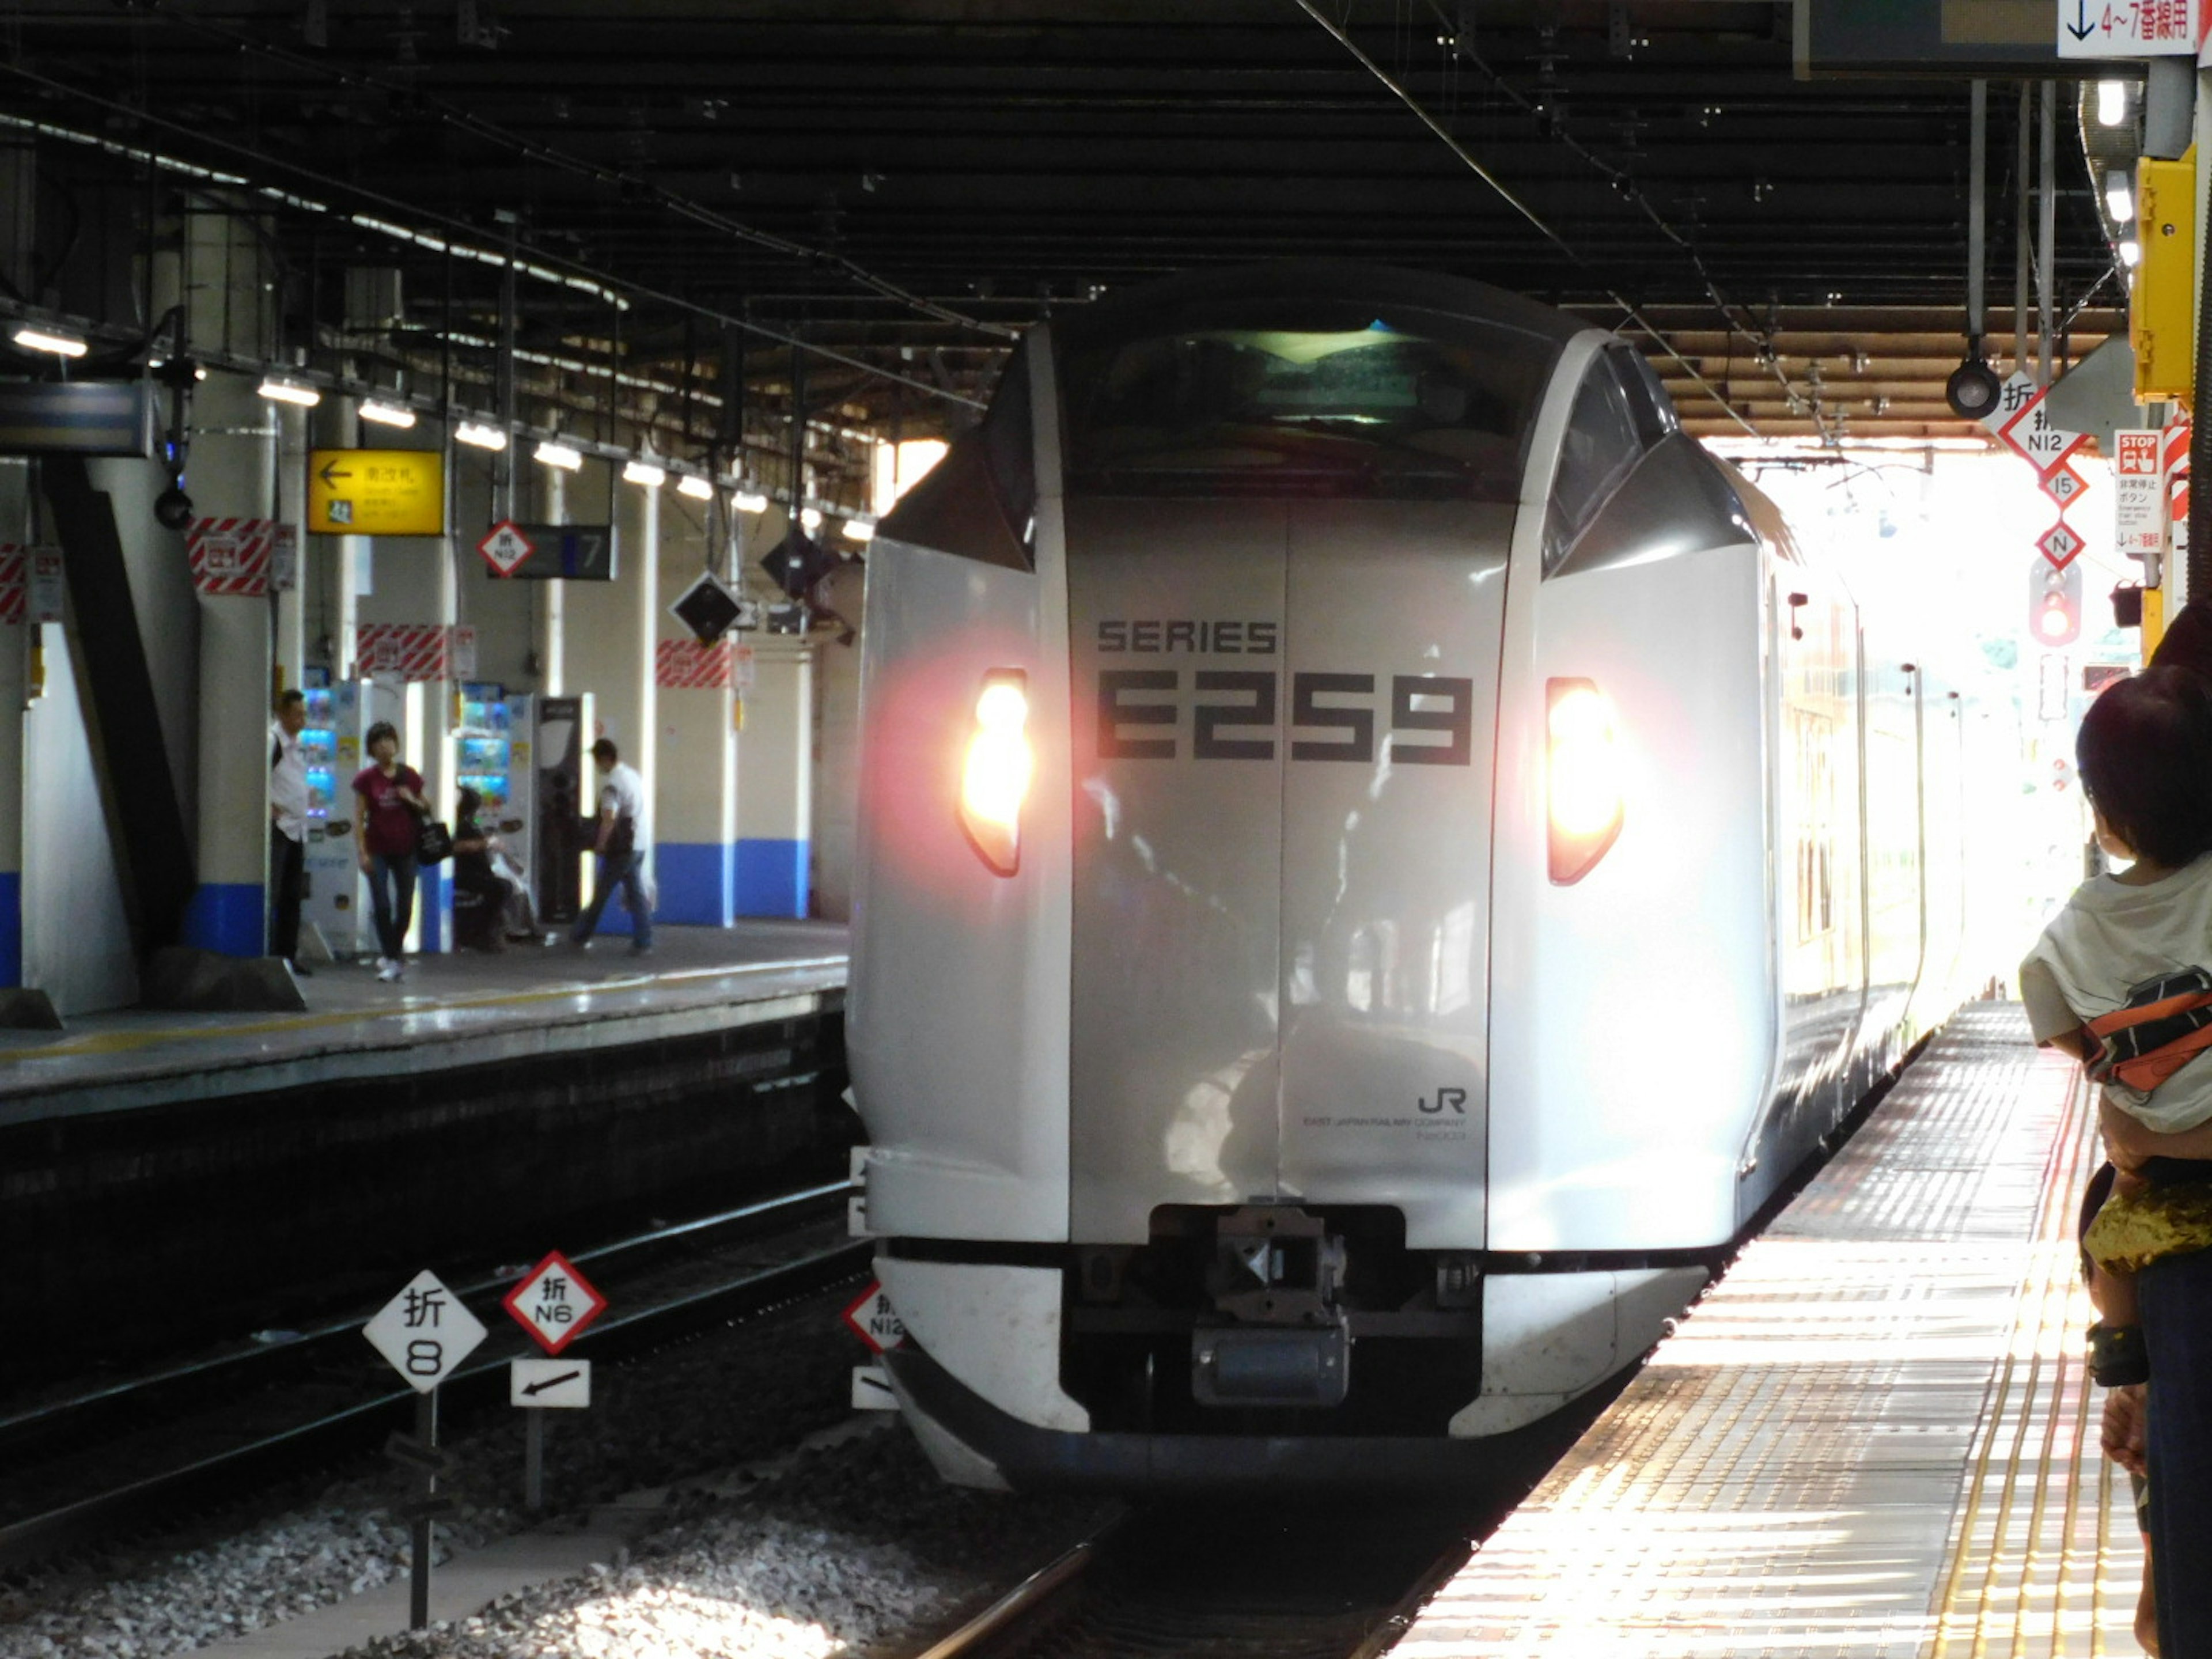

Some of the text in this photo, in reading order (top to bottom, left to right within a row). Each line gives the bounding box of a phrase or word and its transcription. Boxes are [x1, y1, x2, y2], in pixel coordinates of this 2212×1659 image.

[2004, 382, 2034, 411] 折
[2029, 435, 2062, 451] N12
[2122, 437, 2156, 448] STOP
[2055, 478, 2071, 494] 15
[2120, 479, 2157, 490] 非常停止
[2119, 493, 2147, 503] ボタン
[581, 535, 602, 569] 7
[2053, 536, 2067, 552] N
[1098, 620, 1277, 653] SERIES
[1097, 670, 1474, 766] E259
[1418, 1087, 1467, 1113] JR
[543, 1277, 566, 1301] 折
[404, 1288, 446, 1328] 折
[535, 1305, 573, 1324] N6
[870, 1318, 904, 1335] N12
[407, 1339, 442, 1376] 8
